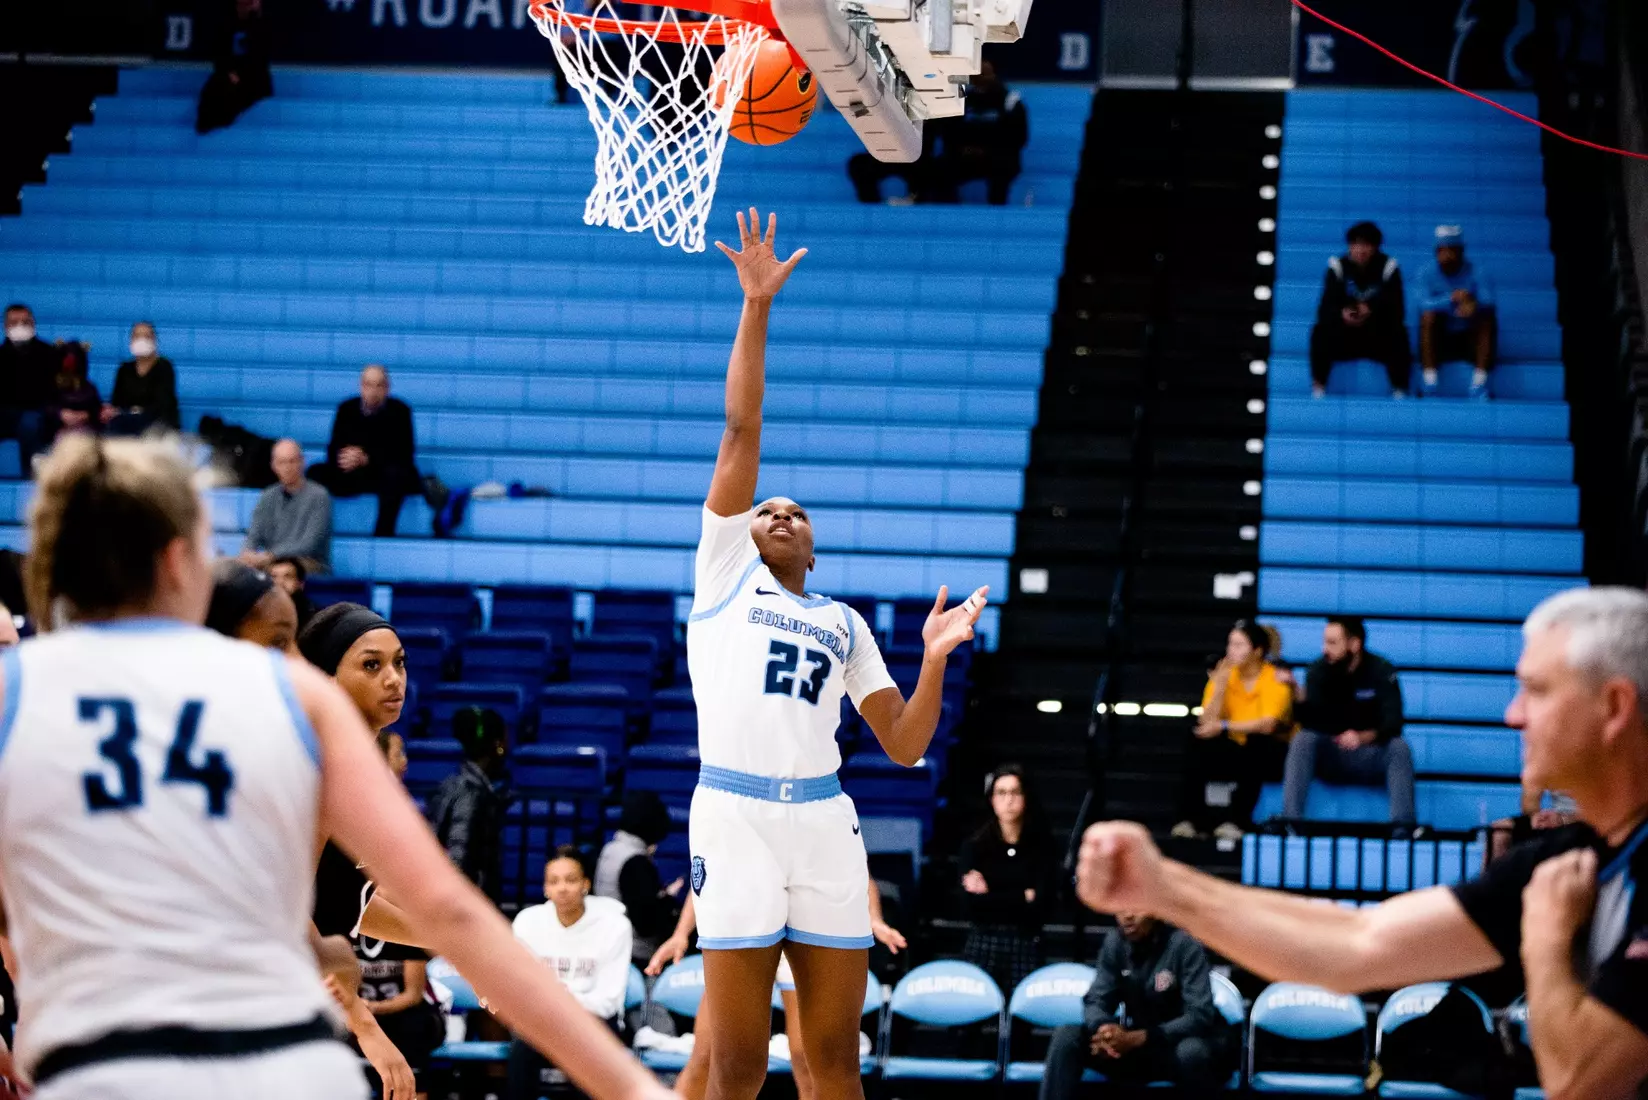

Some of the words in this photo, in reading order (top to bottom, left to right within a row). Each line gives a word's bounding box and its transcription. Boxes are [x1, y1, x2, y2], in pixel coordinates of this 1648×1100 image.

[166, 16, 192, 50] D
[1060, 33, 1089, 70] D
[1306, 34, 1335, 72] E
[748, 607, 846, 665] COLUMBIA
[763, 637, 832, 706] 23
[77, 696, 235, 818] 34
[780, 783, 793, 801] C
